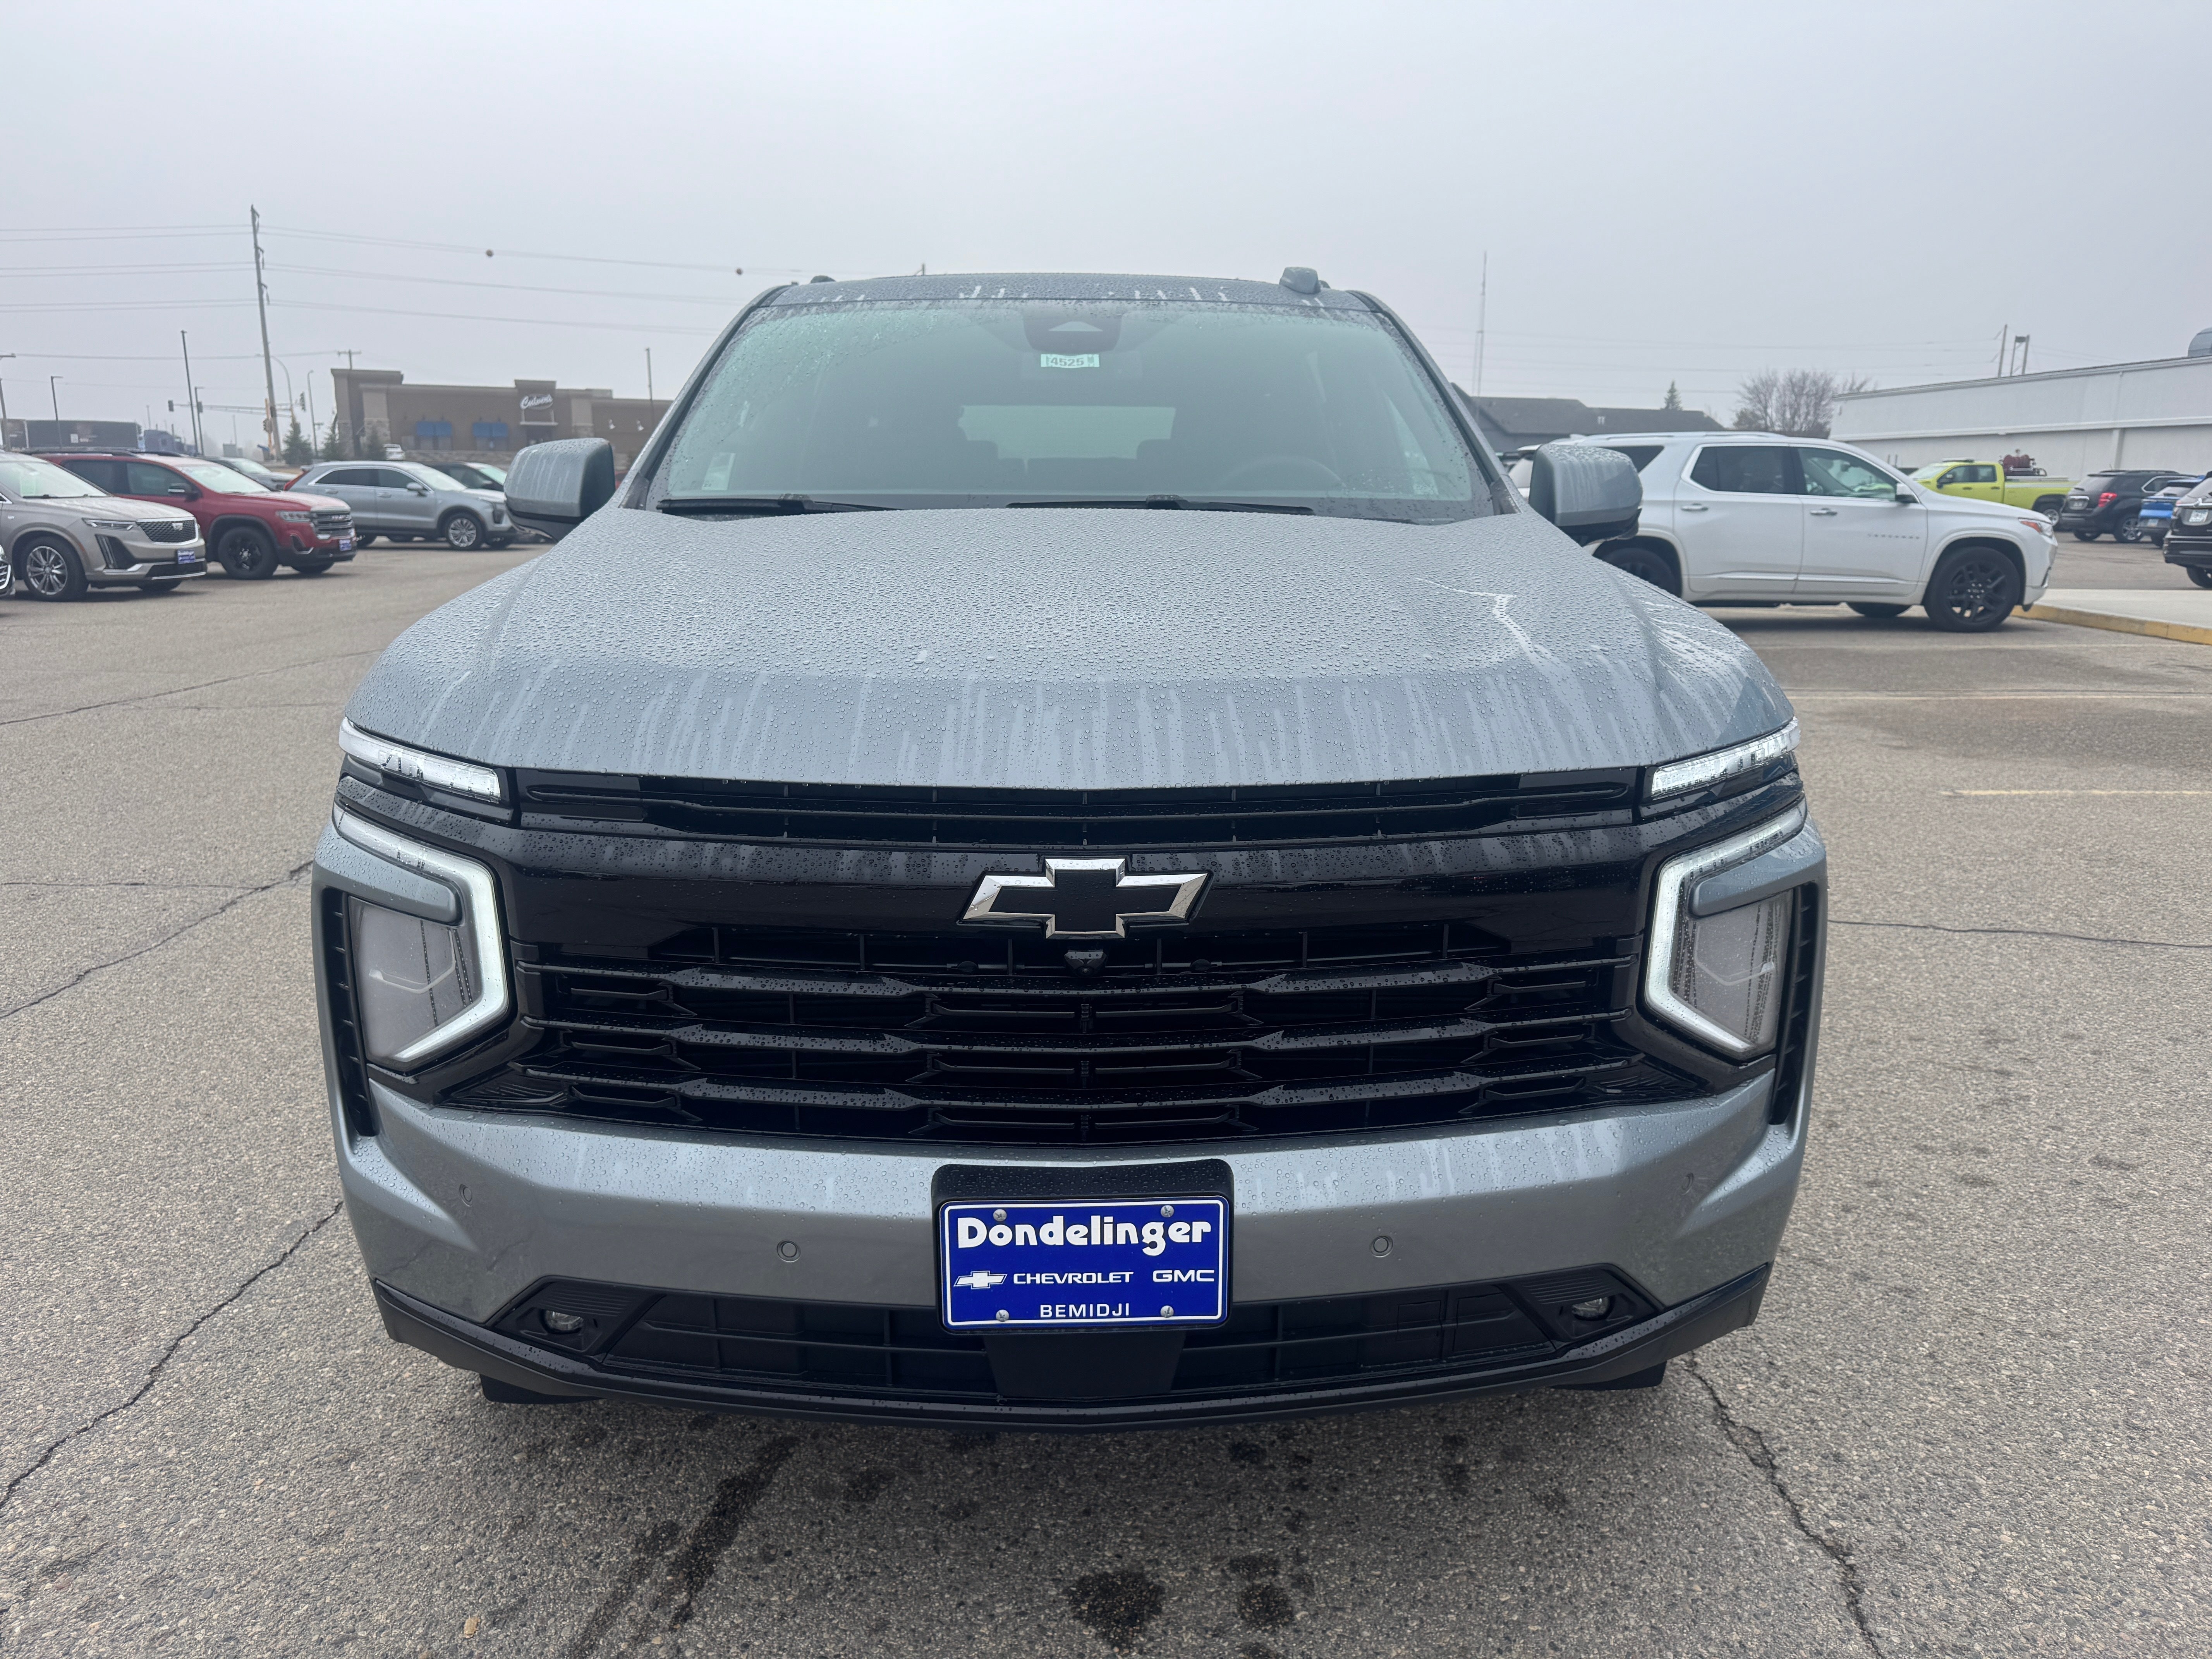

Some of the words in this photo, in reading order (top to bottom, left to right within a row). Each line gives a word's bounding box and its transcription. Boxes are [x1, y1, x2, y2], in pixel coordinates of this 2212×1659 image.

[958, 1216, 1211, 1256] Dondelinger
[1013, 1272, 1134, 1284] CHEVROLET
[1152, 1270, 1214, 1282] GMC
[1040, 1304, 1130, 1317] BEMIDJI
